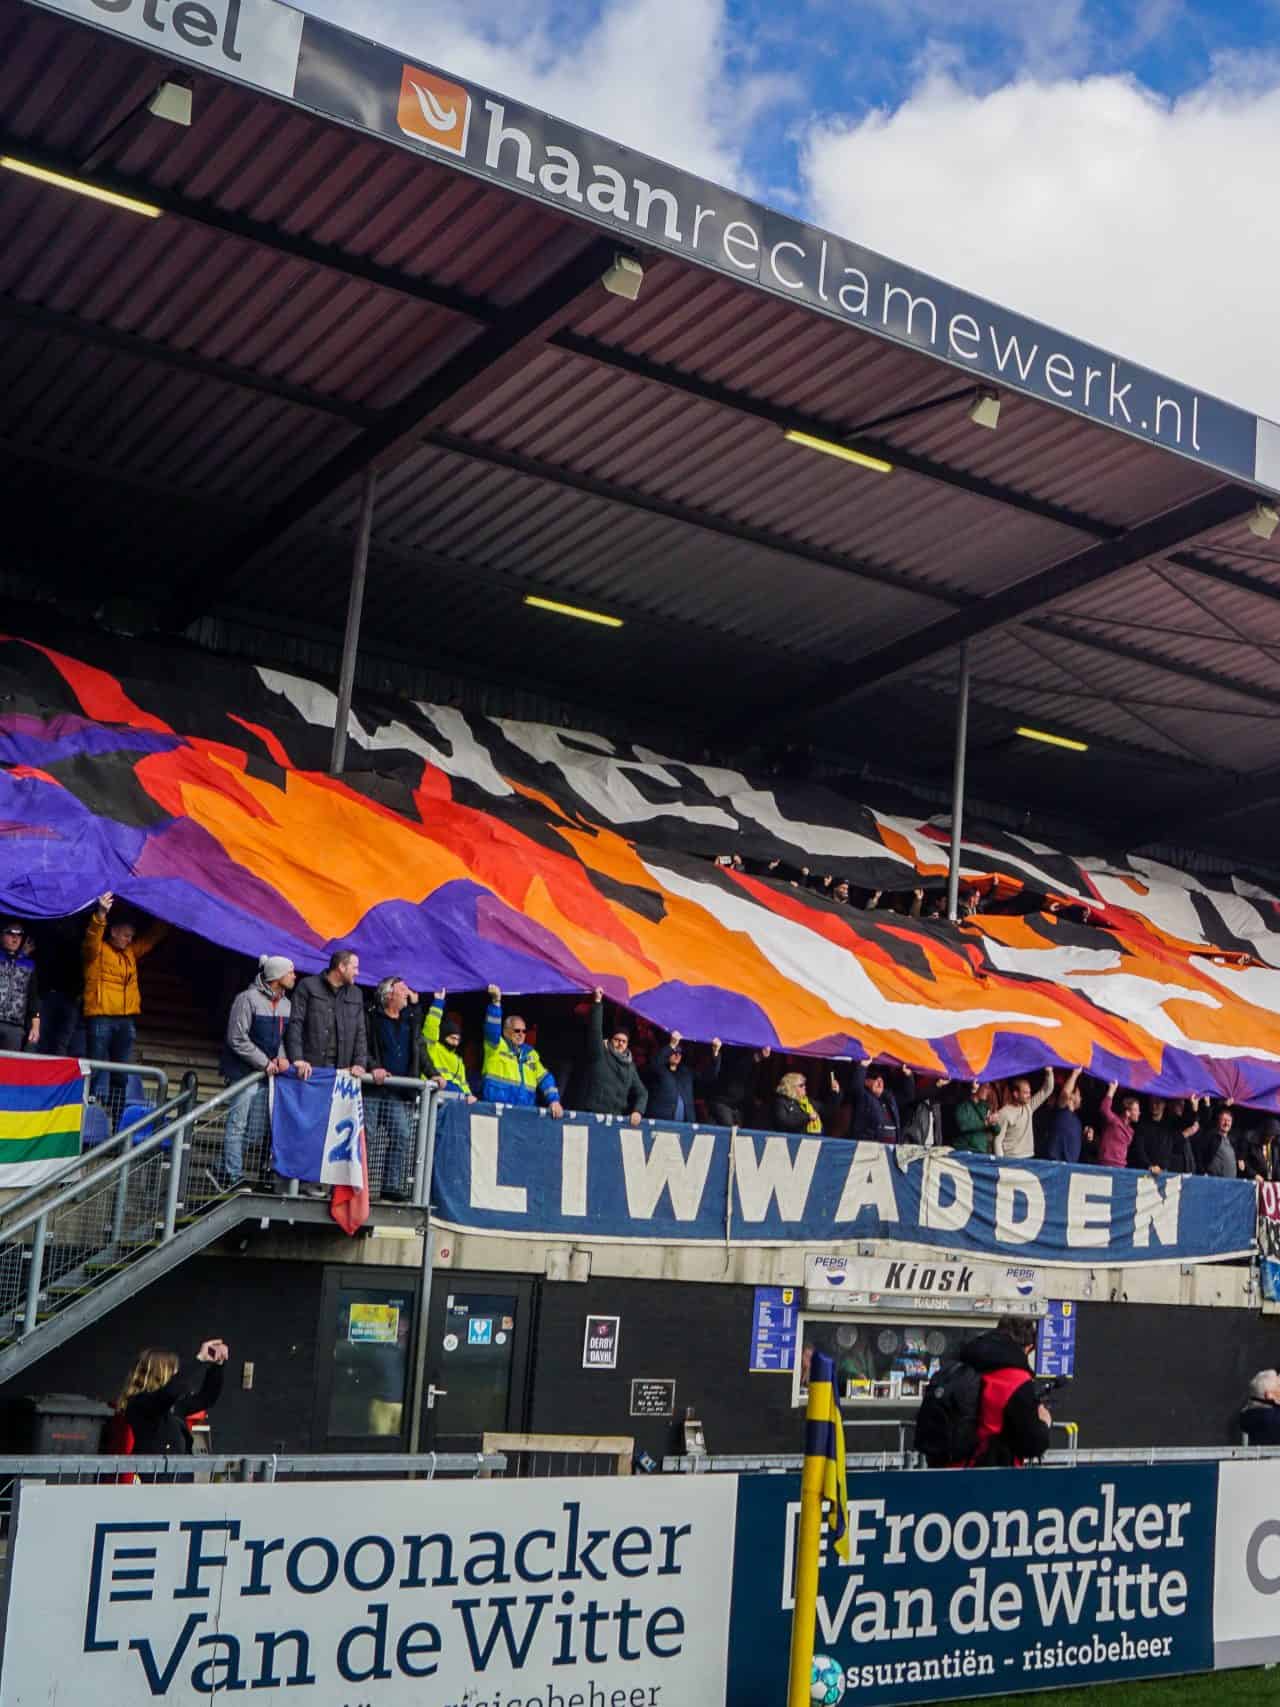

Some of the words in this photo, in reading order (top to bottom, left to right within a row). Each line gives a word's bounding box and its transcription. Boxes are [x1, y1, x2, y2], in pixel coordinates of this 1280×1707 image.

[90, 0, 242, 62] tel
[469, 1114, 1183, 1248] LIWWADDEN
[815, 1256, 847, 1267] PEPSI
[885, 1262, 974, 1293] Kiosk
[1006, 1268, 1035, 1279] PEPSI
[173, 1502, 692, 1599] Froonacker
[838, 1484, 1191, 1566] Froonacker
[815, 1574, 938, 1646] Van
[949, 1567, 1022, 1635] de
[1027, 1559, 1189, 1628] Witte
[129, 1613, 316, 1696] Van
[336, 1604, 442, 1682] de
[452, 1591, 685, 1673] Witte
[846, 1649, 996, 1689] ssurantiën
[1022, 1631, 1173, 1672] risicobeheer
